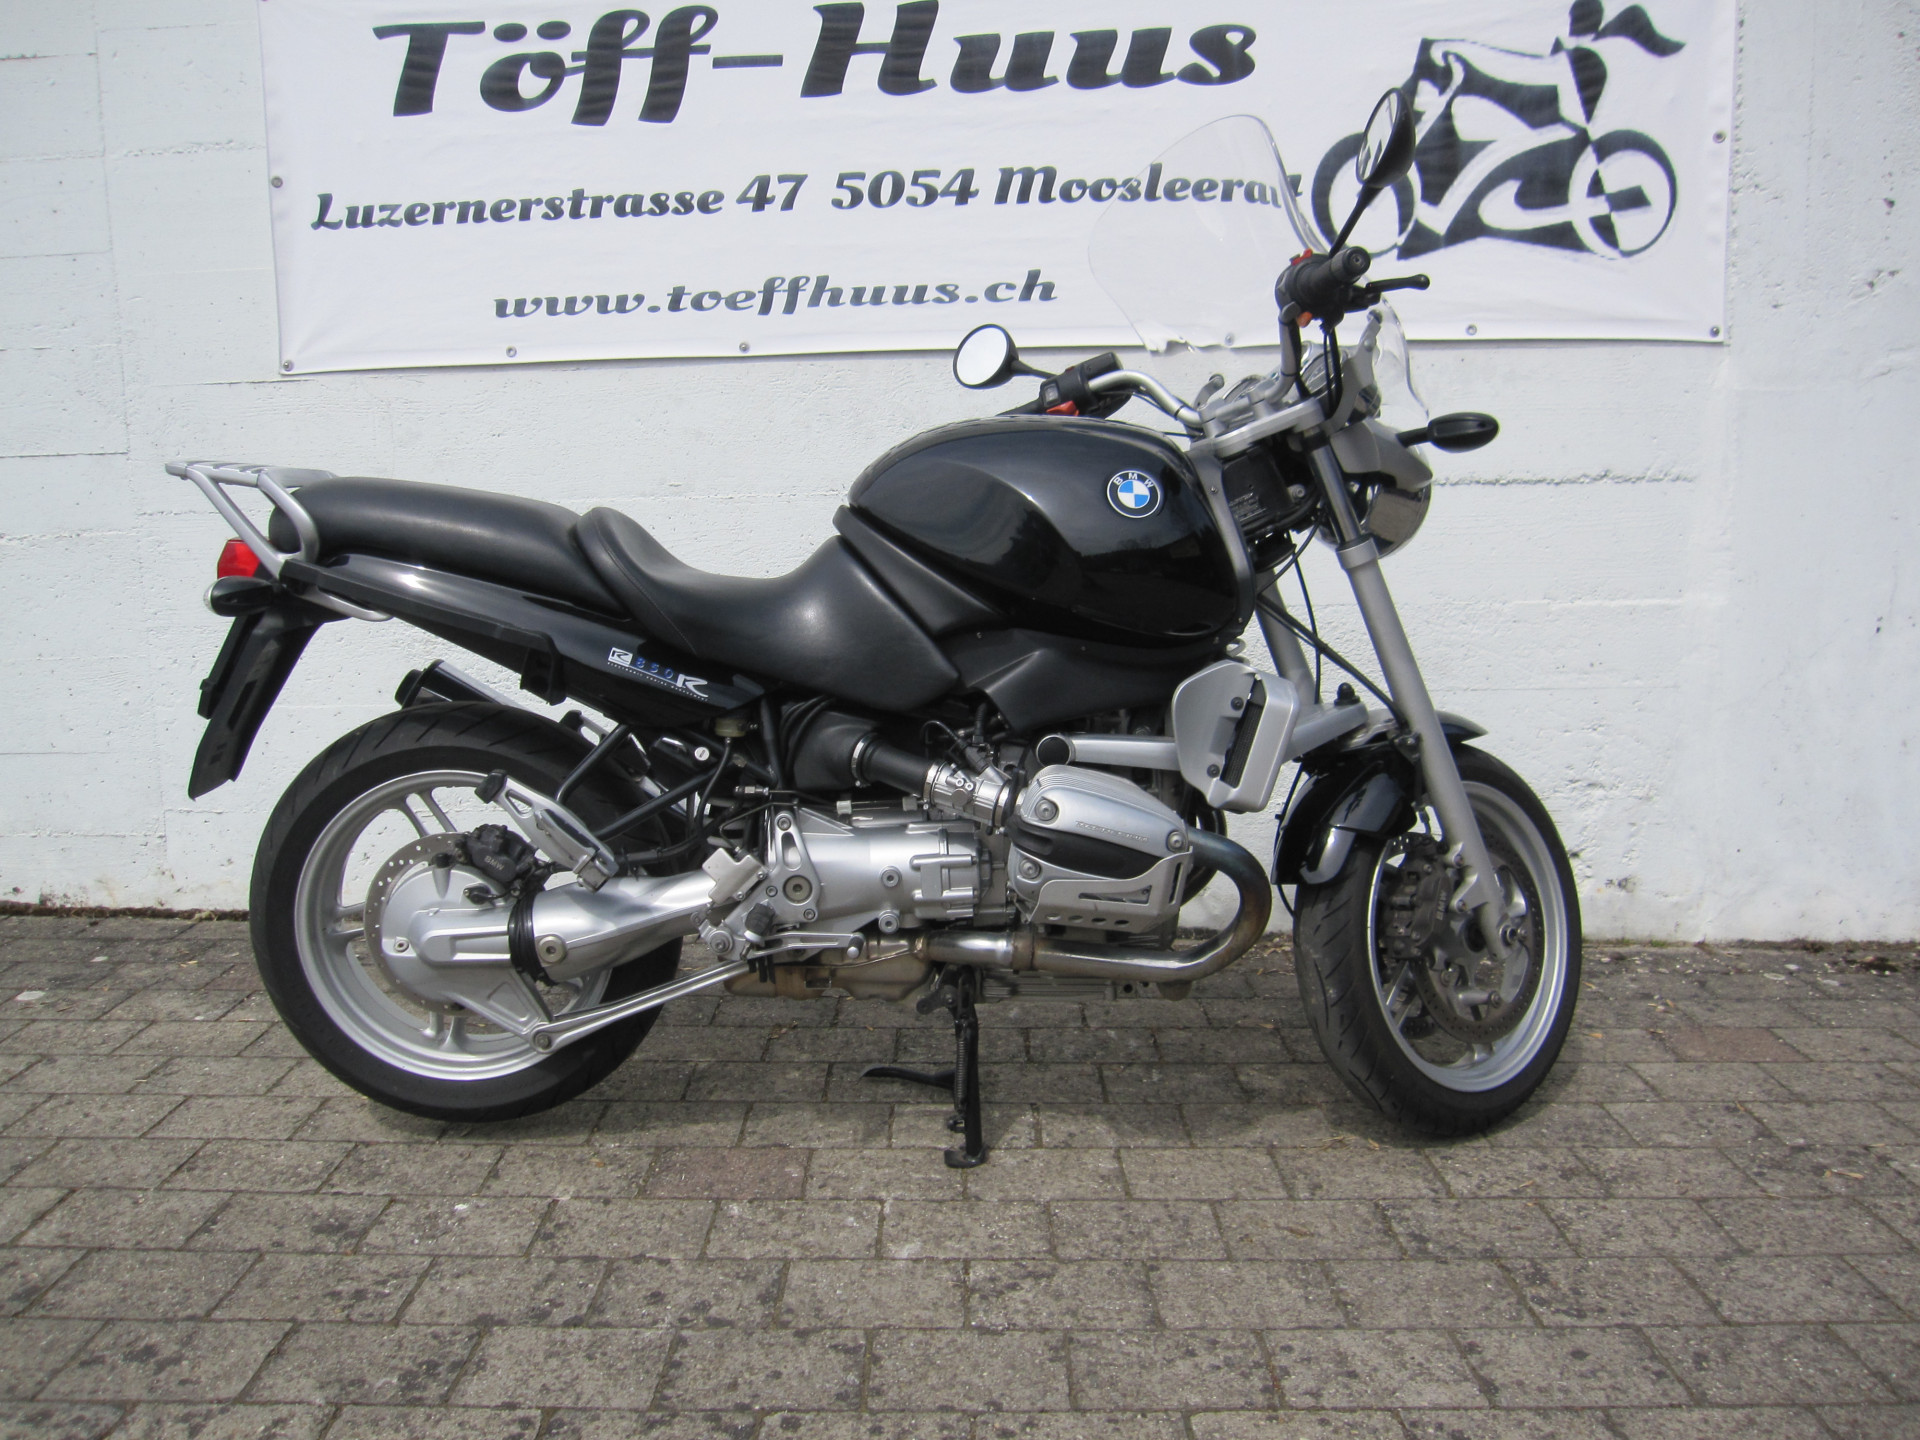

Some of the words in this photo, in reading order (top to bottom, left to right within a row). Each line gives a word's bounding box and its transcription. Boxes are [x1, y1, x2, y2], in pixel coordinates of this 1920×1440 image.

[372, 0, 1257, 126] Töff-Huus
[311, 188, 725, 230] Luzernerstrasse
[736, 174, 808, 212] 47
[831, 168, 980, 210] 5054
[494, 269, 1057, 318] www.toeffhuus.ch
[1113, 472, 1155, 488] BMW
[635, 657, 675, 679] 850
[676, 673, 709, 698] R
[484, 855, 504, 870] BMW
